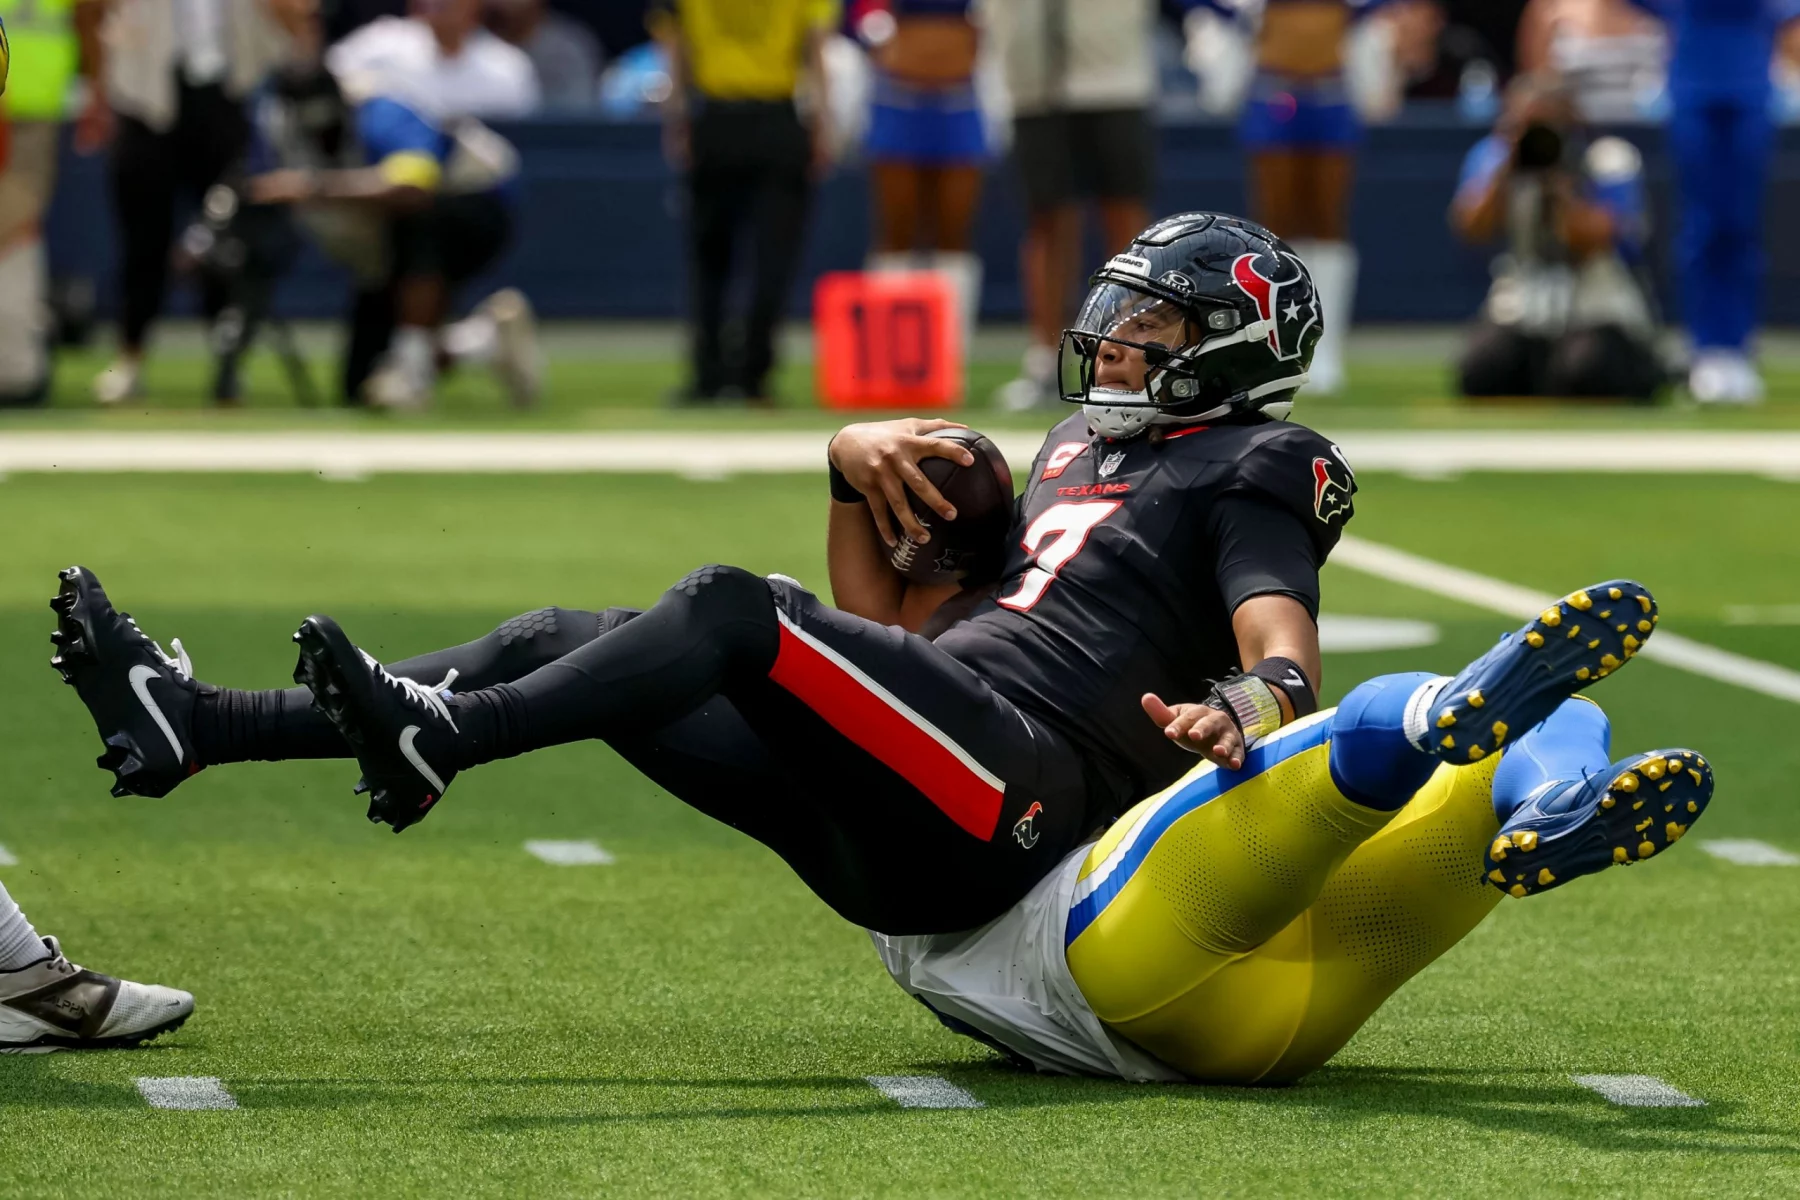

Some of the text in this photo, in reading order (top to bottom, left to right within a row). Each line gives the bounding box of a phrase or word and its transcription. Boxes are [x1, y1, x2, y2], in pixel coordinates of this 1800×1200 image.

[1160, 277, 1192, 294] OAKLEY
[852, 302, 931, 384] 10
[1046, 442, 1088, 470] C
[1056, 483, 1132, 497] TEXANS
[996, 499, 1124, 612] 7
